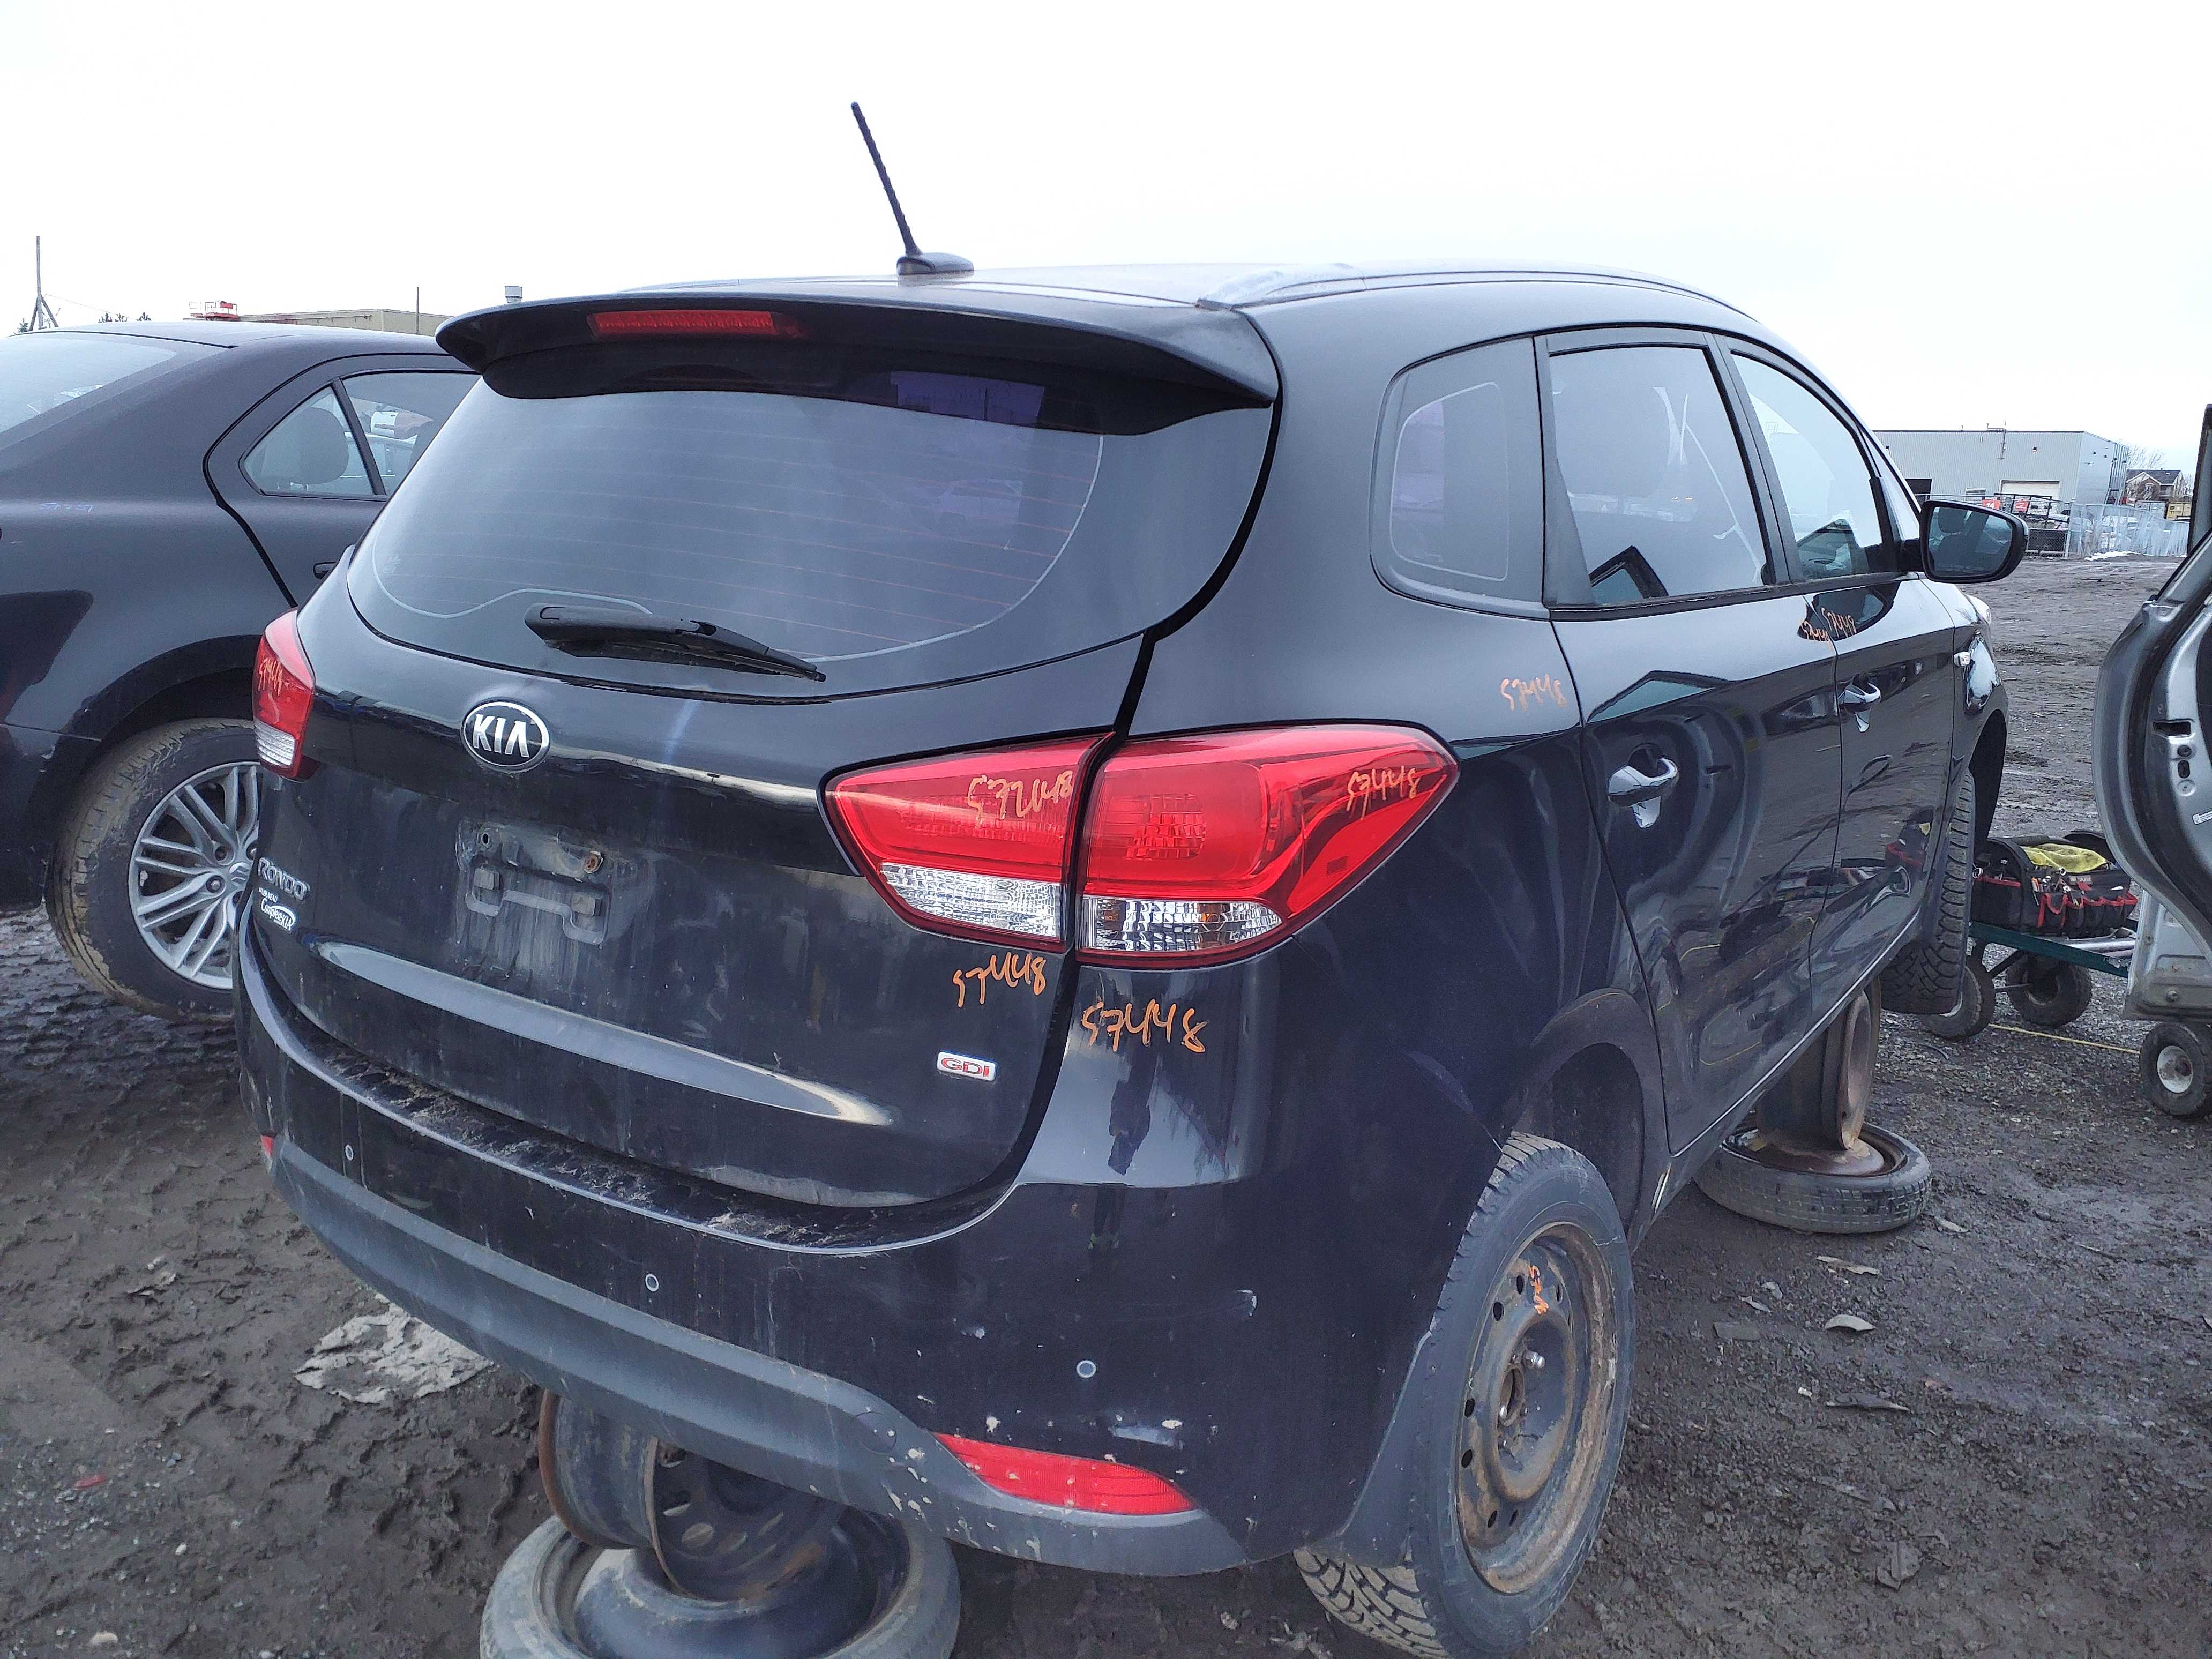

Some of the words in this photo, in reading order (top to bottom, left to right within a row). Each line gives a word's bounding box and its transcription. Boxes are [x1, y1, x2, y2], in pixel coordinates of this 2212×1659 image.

[473, 714, 529, 758] KIA
[1346, 765, 1421, 820] 57448
[258, 857, 309, 900] RONDO
[953, 952, 1047, 1007] 57448
[1081, 999, 1209, 1052] 57448
[941, 1057, 990, 1077] GDI
